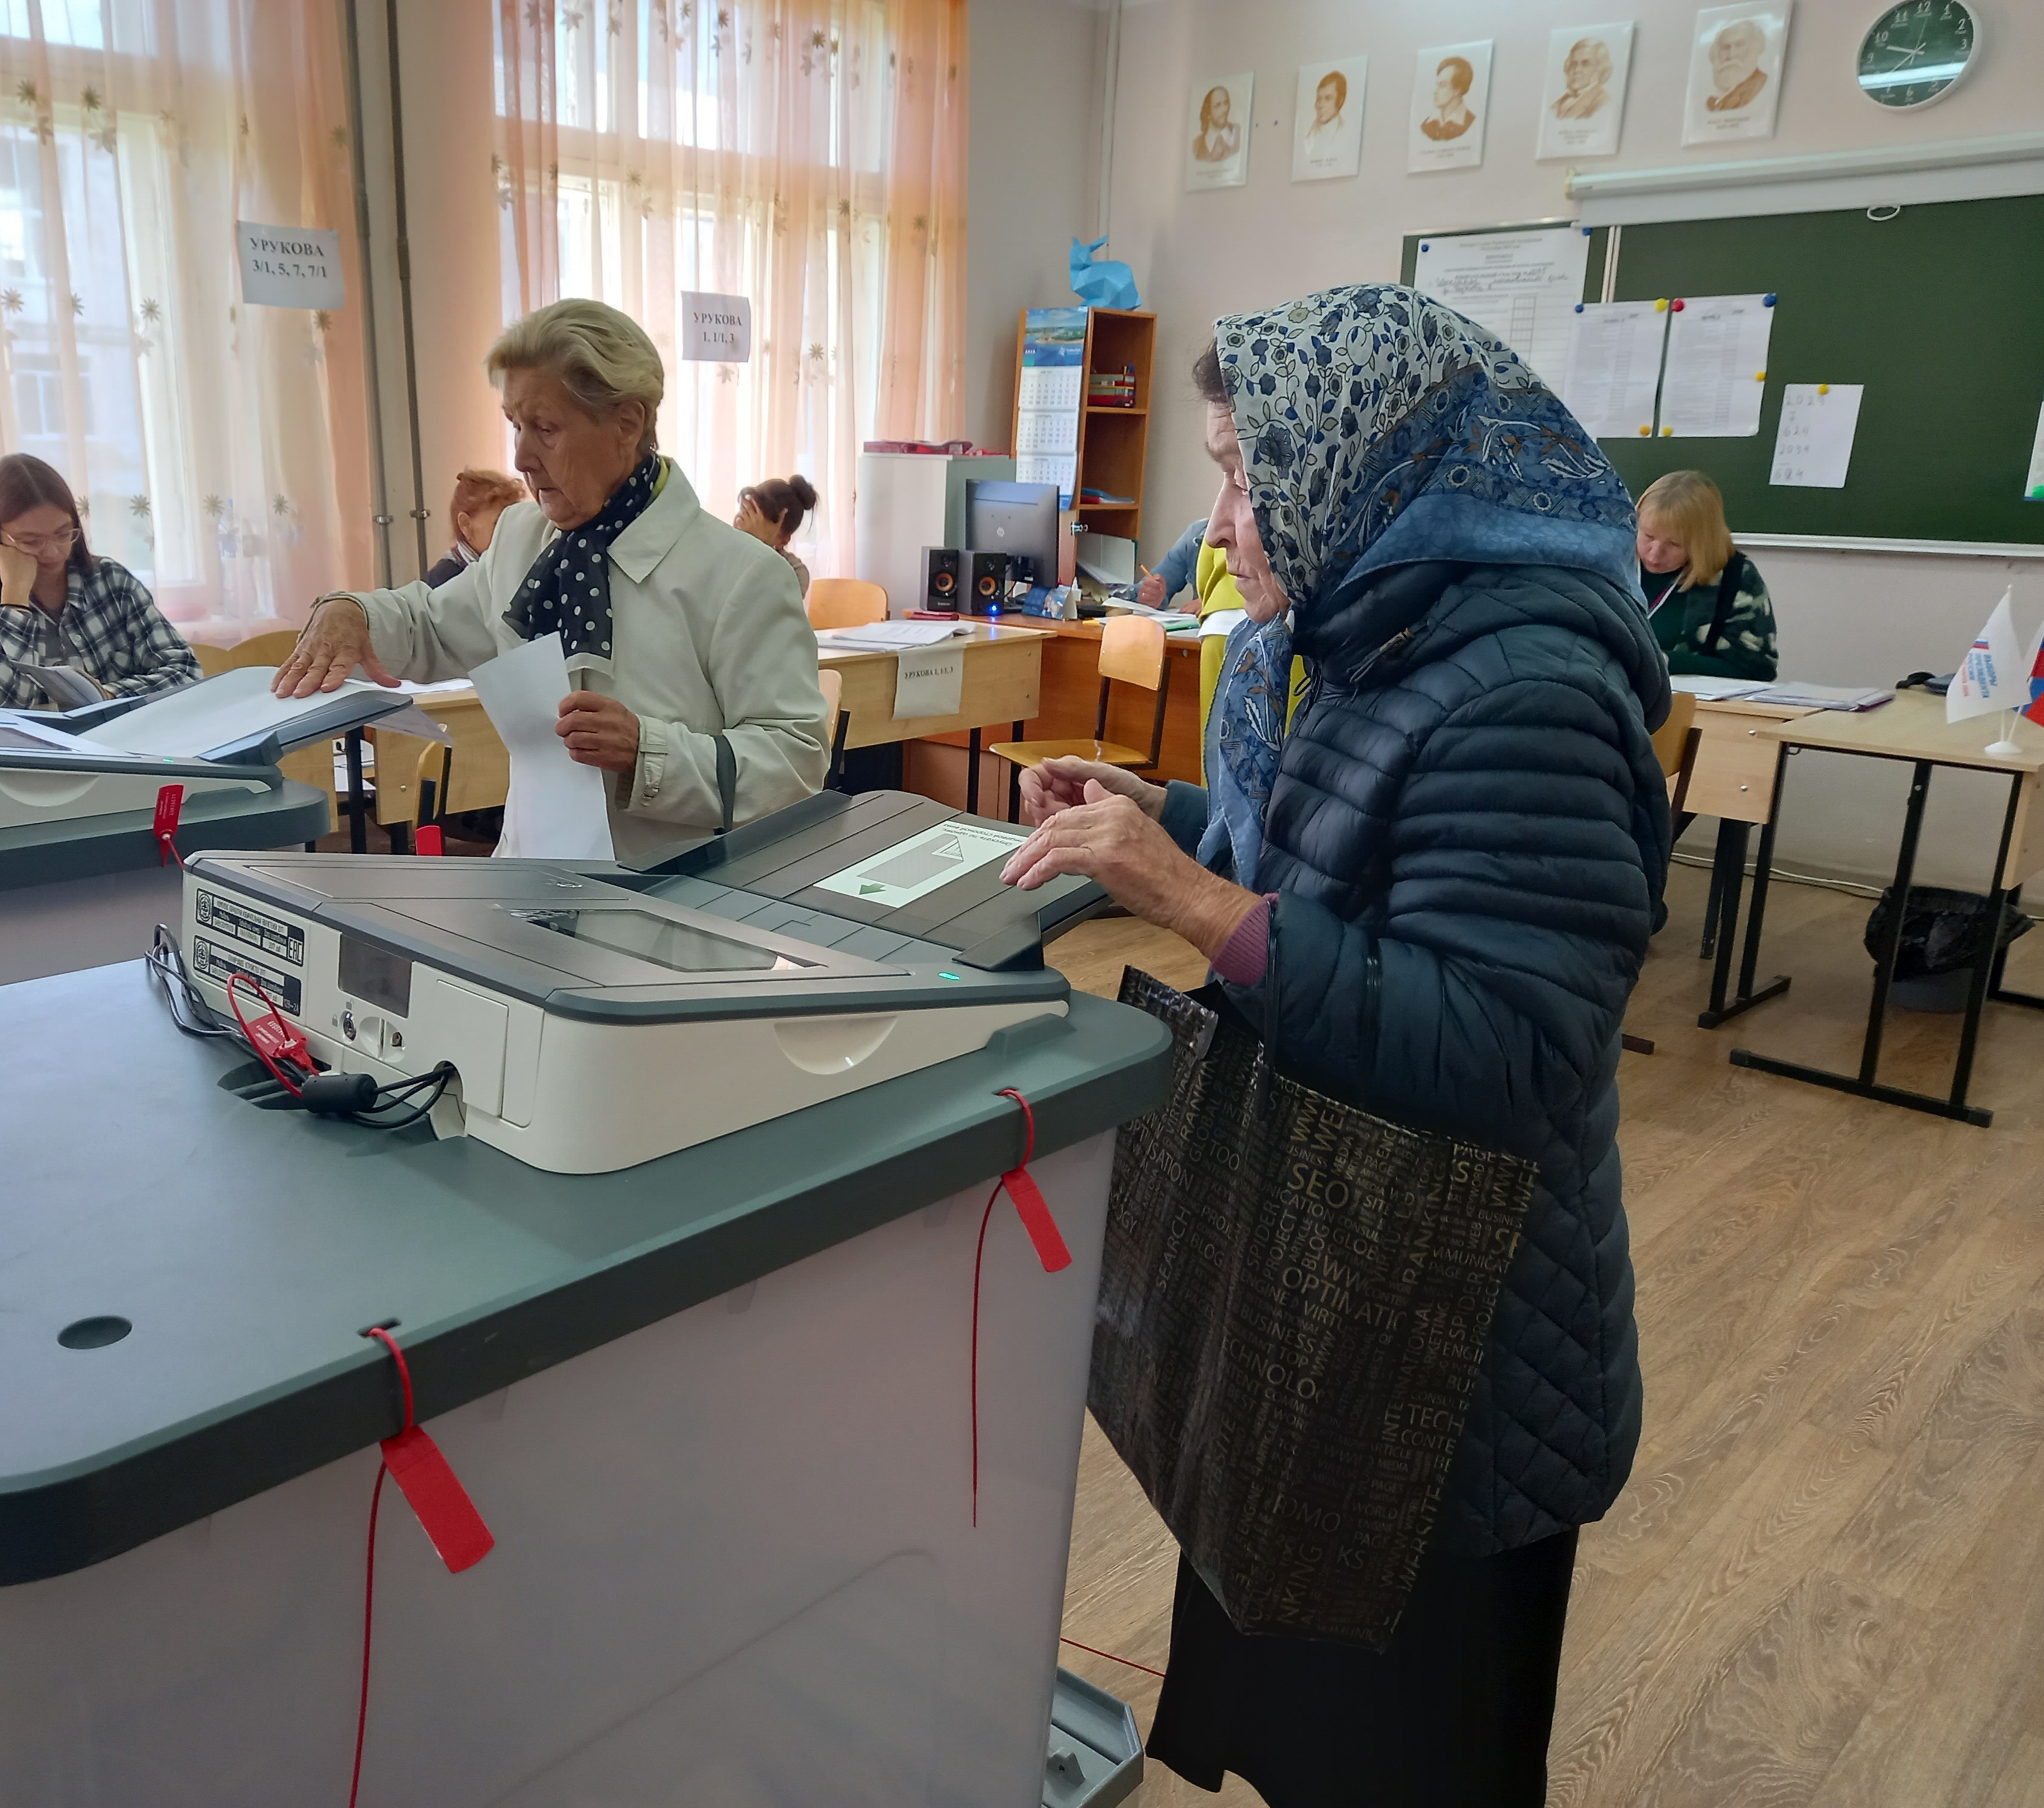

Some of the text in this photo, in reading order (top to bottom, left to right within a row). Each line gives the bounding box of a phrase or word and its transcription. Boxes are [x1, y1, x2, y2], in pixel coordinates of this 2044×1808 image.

[1895, 11, 1908, 22] 11
[1917, 2, 1930, 13] 12
[1944, 4, 1950, 14] 1
[1958, 19, 1965, 30] 2
[1875, 31, 1889, 43] 10
[1960, 39, 1967, 49] 3
[1866, 52, 1874, 64] 9
[249, 237, 325, 257] УРУКОВА
[252, 259, 327, 278] 3/1, 5, 7, 7/1
[693, 312, 742, 327] УРУКОВА
[703, 331, 735, 344] 1, 1/1, 3
[904, 669, 933, 679] УРУКОВА
[959, 827, 993, 837] стороной
[980, 836, 1012, 846] Опускать
[1190, 1097, 1223, 1162] GLOBAL
[1287, 1162, 1350, 1209] SEO
[1246, 1200, 1280, 1272] SPIDER
[1262, 1208, 1297, 1281] PROJECT
[1288, 1216, 1313, 1263] ARTICLE
[1155, 1205, 1191, 1293] SEARCH
[1190, 1232, 1225, 1267] BLOG
[1300, 1222, 1331, 1272] BLOG
[1449, 1272, 1486, 1342] SPIDER
[1469, 1275, 1502, 1346] PROJECT
[1240, 1303, 1317, 1354] BUSINESS
[1280, 1345, 1309, 1368] TOP
[1381, 1298, 1434, 1443] INTERNATIONAL
[1407, 1402, 1466, 1437] TECH
[1400, 1428, 1457, 1456] CONTE
[1352, 1530, 1391, 1549] PAGE
